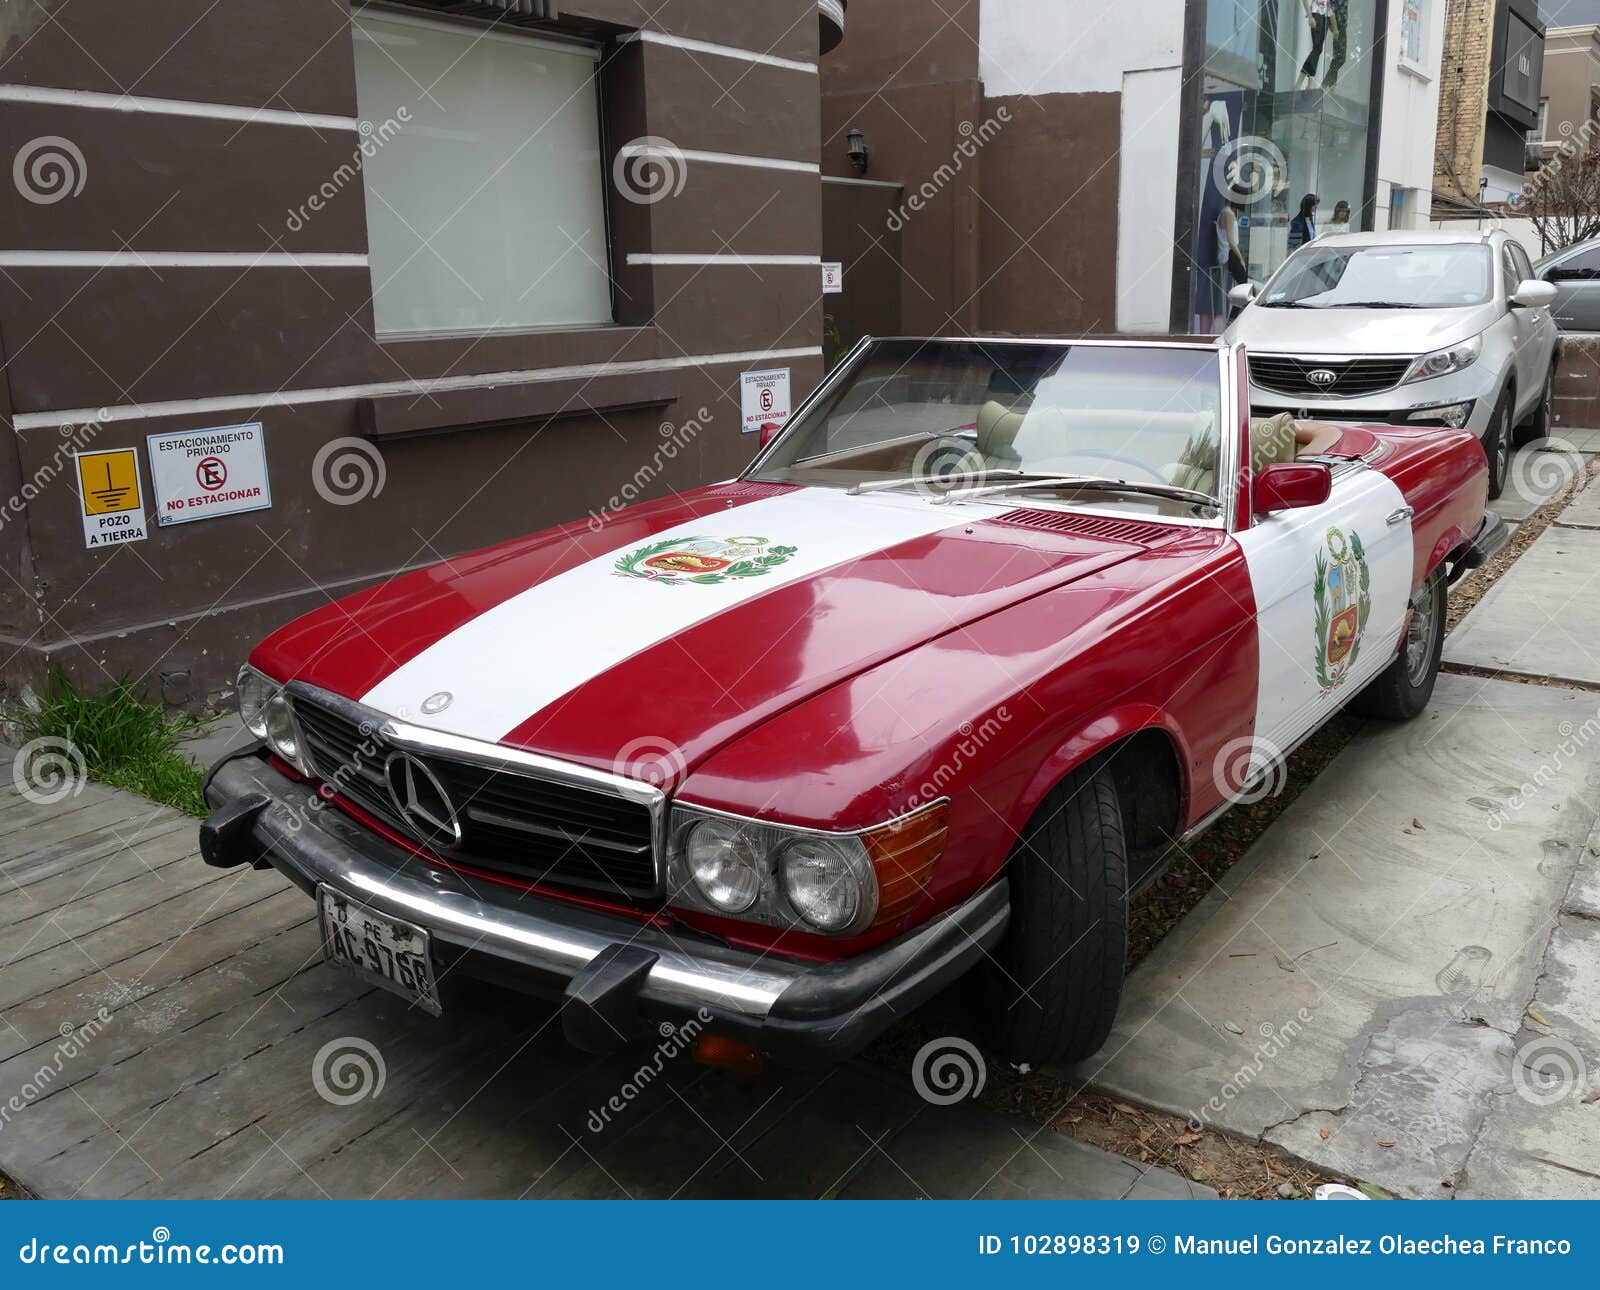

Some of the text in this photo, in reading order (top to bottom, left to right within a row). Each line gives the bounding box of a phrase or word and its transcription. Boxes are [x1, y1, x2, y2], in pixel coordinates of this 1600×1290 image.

[745, 373, 786, 384] ESTACIONAMIENTO
[1311, 373, 1331, 382] KIA
[755, 411, 787, 421] ESTACIONAR
[159, 431, 254, 451] ESTACIONAMIENTO
[186, 444, 230, 458] PRIVADO
[167, 487, 261, 511] NO ESTACIONAR
[99, 515, 130, 528] POZO
[90, 527, 143, 545] A TIERRA
